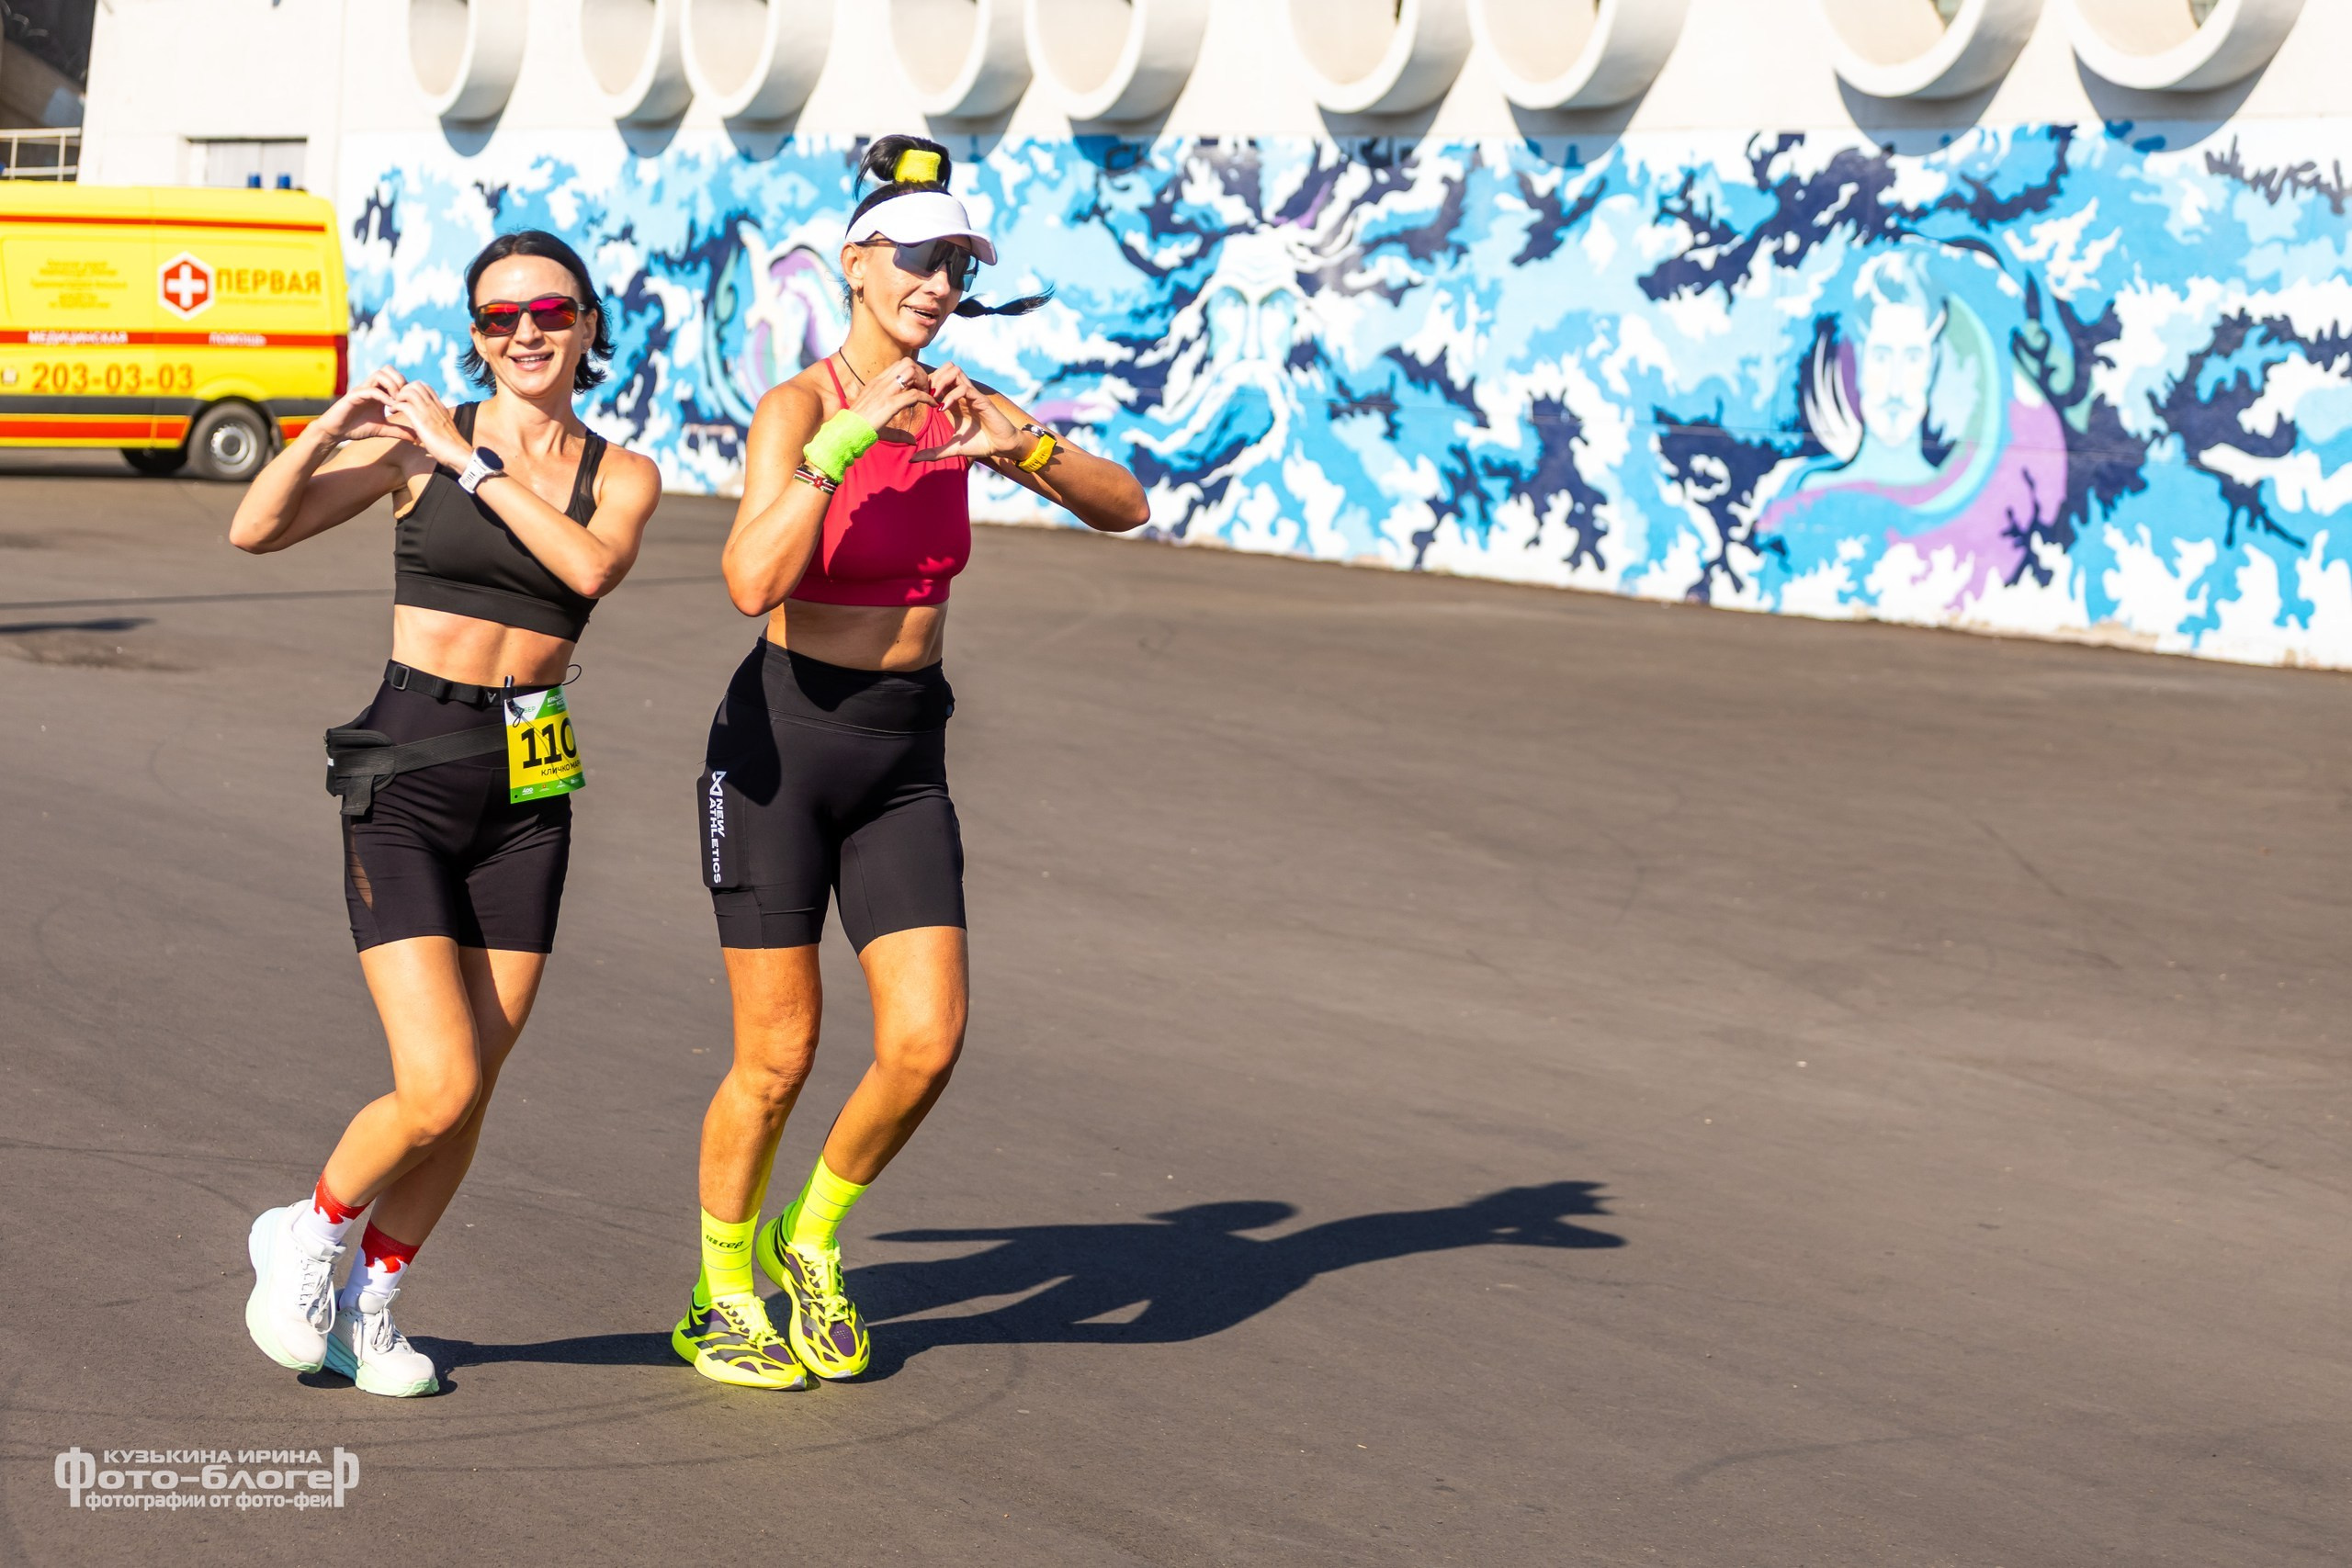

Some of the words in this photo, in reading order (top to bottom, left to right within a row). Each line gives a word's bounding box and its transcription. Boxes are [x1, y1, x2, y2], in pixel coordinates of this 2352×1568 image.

[217, 268, 321, 294] ПЕРВАЯ
[28, 330, 129, 346] МЕДИЦИНСКАЯ
[209, 332, 266, 347] ПОМОЩЬ
[33, 362, 195, 394] 203-03-03
[541, 763, 570, 776] КЛИЧКО
[716, 797, 726, 838] NEW
[709, 796, 721, 884] ATHLETICS
[718, 1240, 744, 1249] cep
